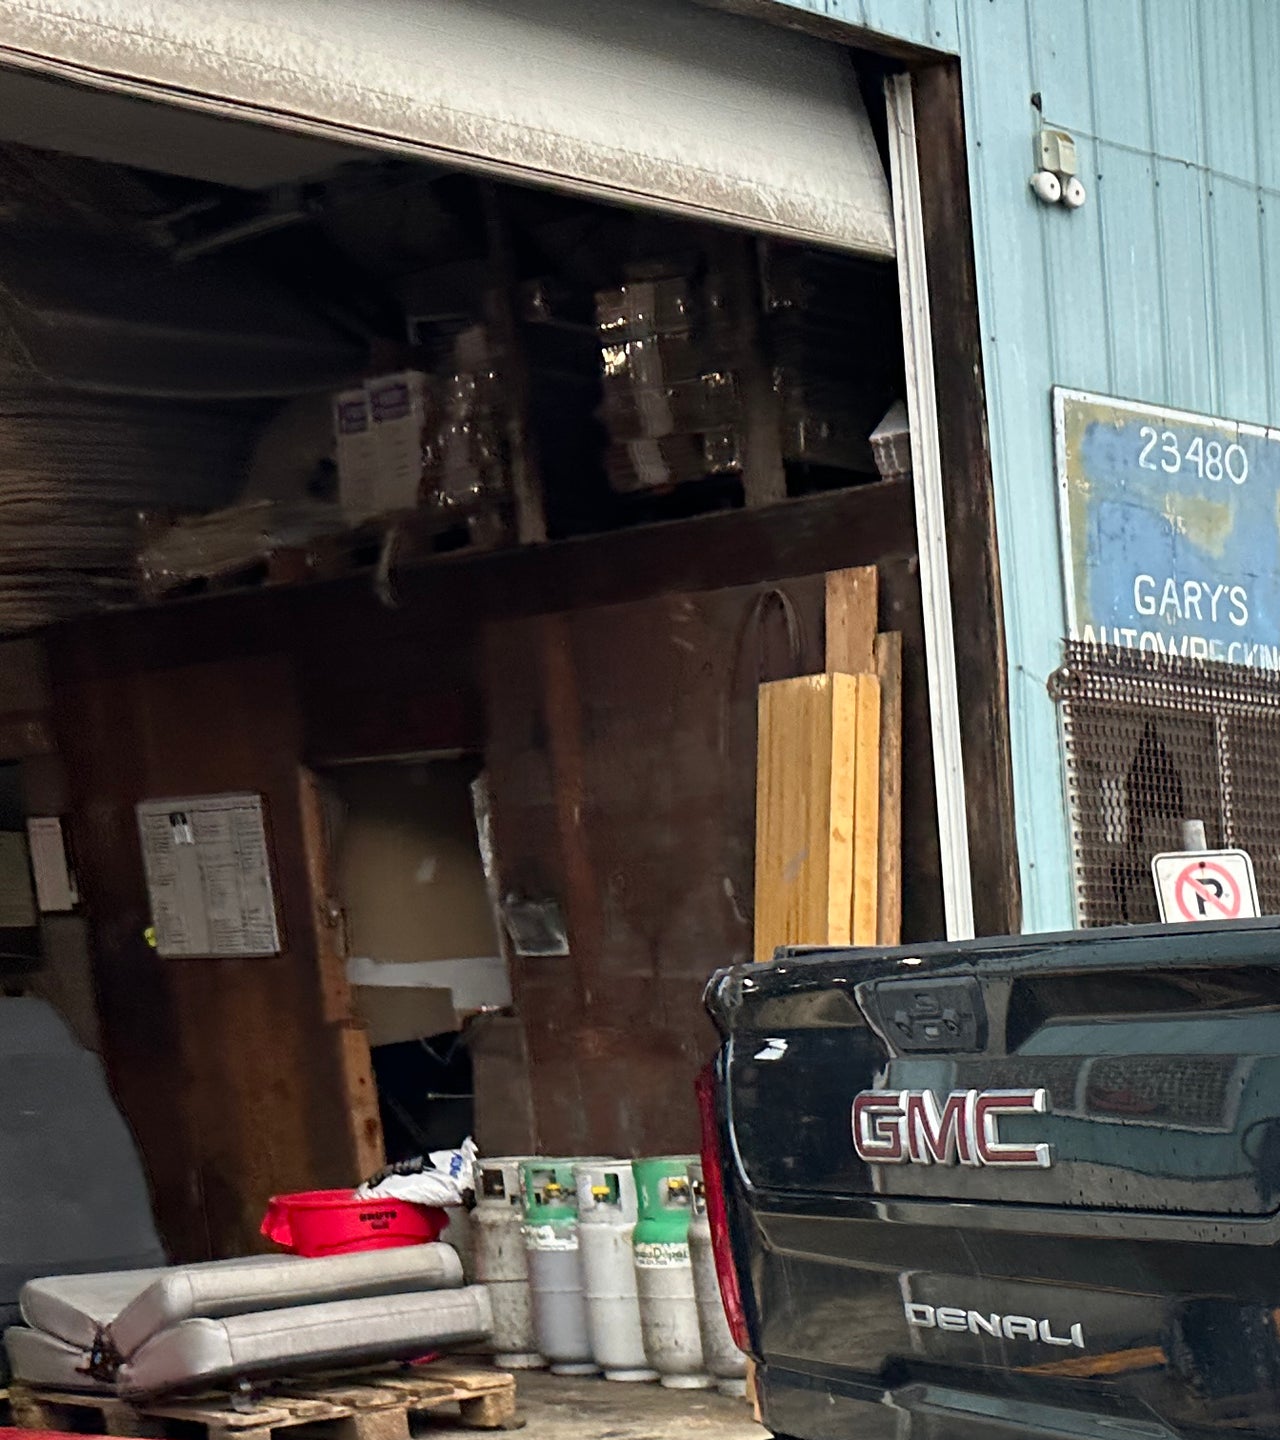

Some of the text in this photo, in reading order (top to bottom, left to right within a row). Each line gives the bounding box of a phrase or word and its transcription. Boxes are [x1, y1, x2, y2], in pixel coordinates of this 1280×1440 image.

[1138, 426, 1249, 485] 23480
[1133, 574, 1249, 627] GARY'S
[851, 1088, 1052, 1169] GMC
[903, 1301, 1085, 1348] DENALI
